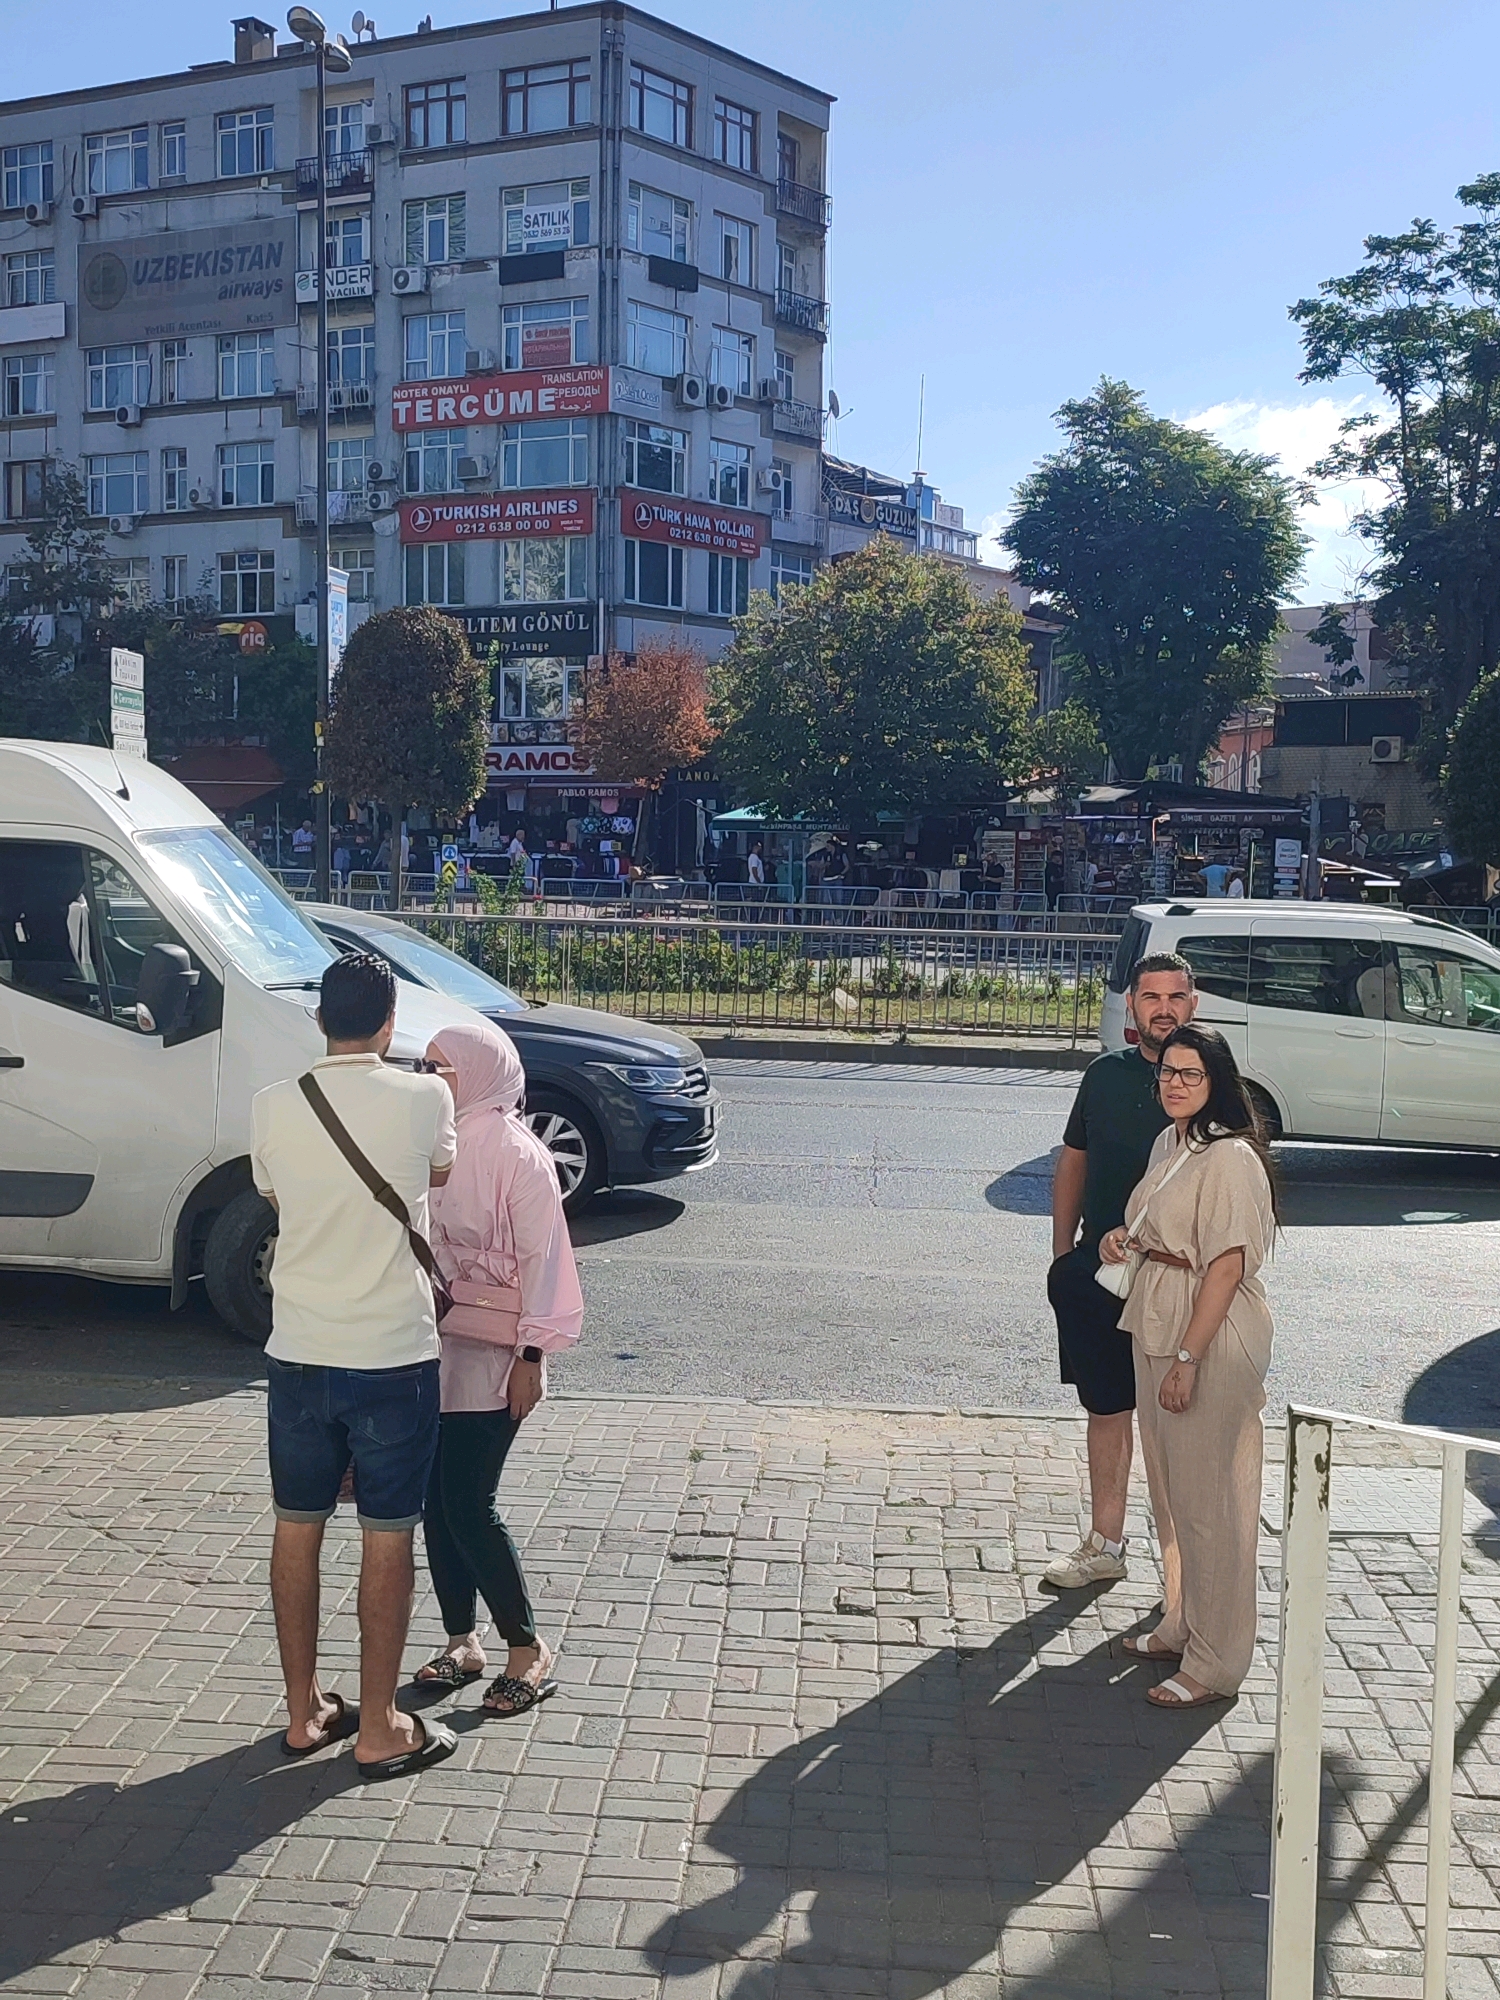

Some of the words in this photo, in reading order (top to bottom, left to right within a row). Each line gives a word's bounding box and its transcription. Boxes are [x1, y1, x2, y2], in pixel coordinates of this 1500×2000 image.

[524, 210, 570, 229] SATILIK
[132, 241, 284, 285] UZBEKISTAN
[218, 277, 284, 301] airways
[144, 323, 174, 335] Yetkili
[542, 369, 604, 385] TRANSLATION
[393, 388, 428, 399] NOTER
[431, 384, 469, 396] ONAYLI
[393, 388, 556, 424] TERCÜME
[433, 503, 500, 521] TURKISH
[505, 499, 578, 517] AIRLINES
[455, 523, 485, 534] 0212
[489, 522, 512, 532] 638
[516, 520, 531, 530] 00
[535, 519, 550, 530] 00
[652, 505, 682, 524] TÜRK
[684, 513, 711, 530] HAVA
[714, 517, 754, 539] YOLLARI
[670, 527, 692, 540] 0212
[695, 532, 710, 544] 638
[713, 535, 724, 546] 00
[726, 537, 737, 549] 00
[522, 610, 589, 632] GÖNÜL
[242, 626, 265, 647] ria
[512, 642, 550, 653] Lounge
[485, 752, 590, 771] RAMOS
[558, 788, 585, 797] PABLO
[588, 788, 619, 797] RAMOS
